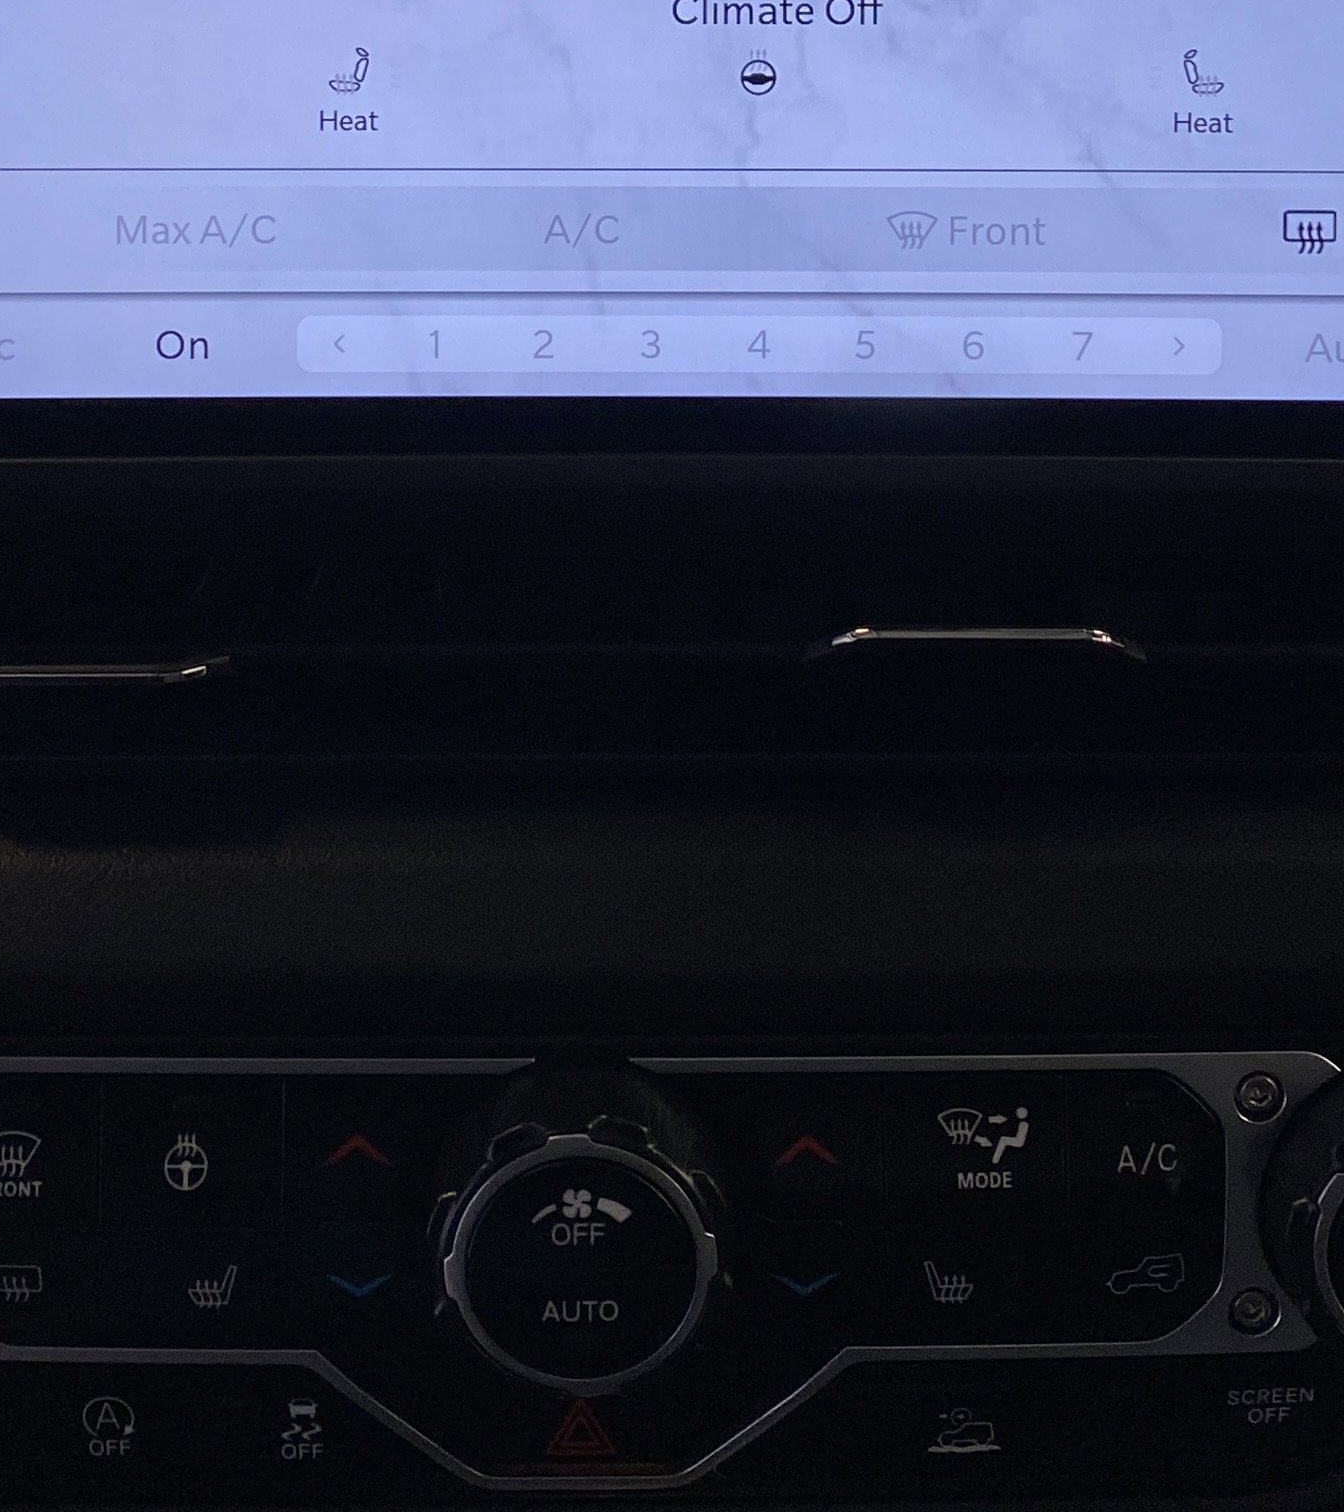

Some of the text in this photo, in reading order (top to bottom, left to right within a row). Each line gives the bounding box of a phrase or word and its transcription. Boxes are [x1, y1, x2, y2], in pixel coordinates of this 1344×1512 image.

[319, 111, 379, 132] Heat
[1173, 111, 1233, 136] Heat
[115, 213, 278, 248] Max A/C
[544, 212, 620, 248] A/C
[948, 215, 1047, 248] Front
[156, 332, 210, 361] On
[429, 332, 1093, 360] 1 2 3 4 5 6 7
[1117, 1143, 1178, 1175] A/C
[957, 1172, 1013, 1190] MODE
[551, 1223, 605, 1246] OFF
[541, 1300, 619, 1322] AUTO
[1227, 1388, 1314, 1406] SCREEN
[1248, 1407, 1290, 1424] OFF
[89, 1439, 131, 1457] OFF
[281, 1443, 324, 1460] OFF
